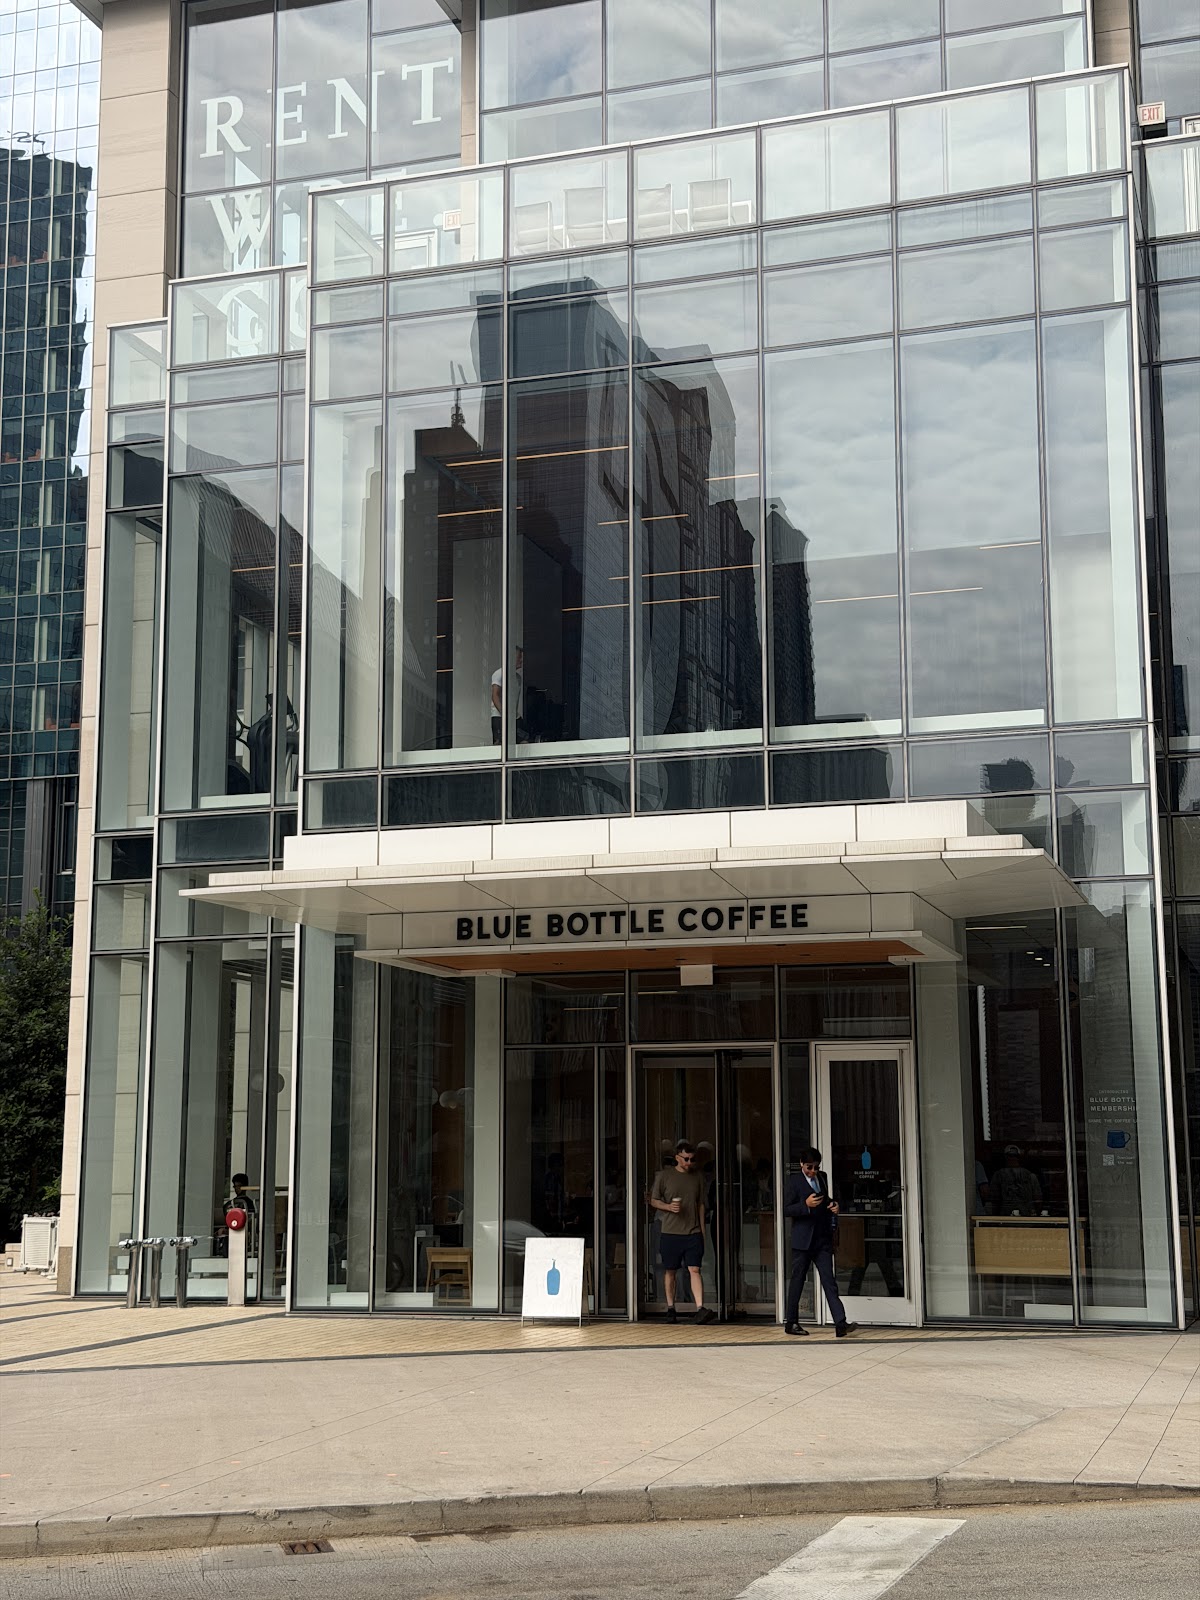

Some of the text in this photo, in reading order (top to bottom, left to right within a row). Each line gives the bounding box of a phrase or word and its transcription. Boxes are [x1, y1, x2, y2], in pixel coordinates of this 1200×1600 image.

[200, 56, 454, 159] RENT
[1141, 106, 1161, 121] EXIT
[456, 904, 808, 940] BLUE BOTTLE COFFEE
